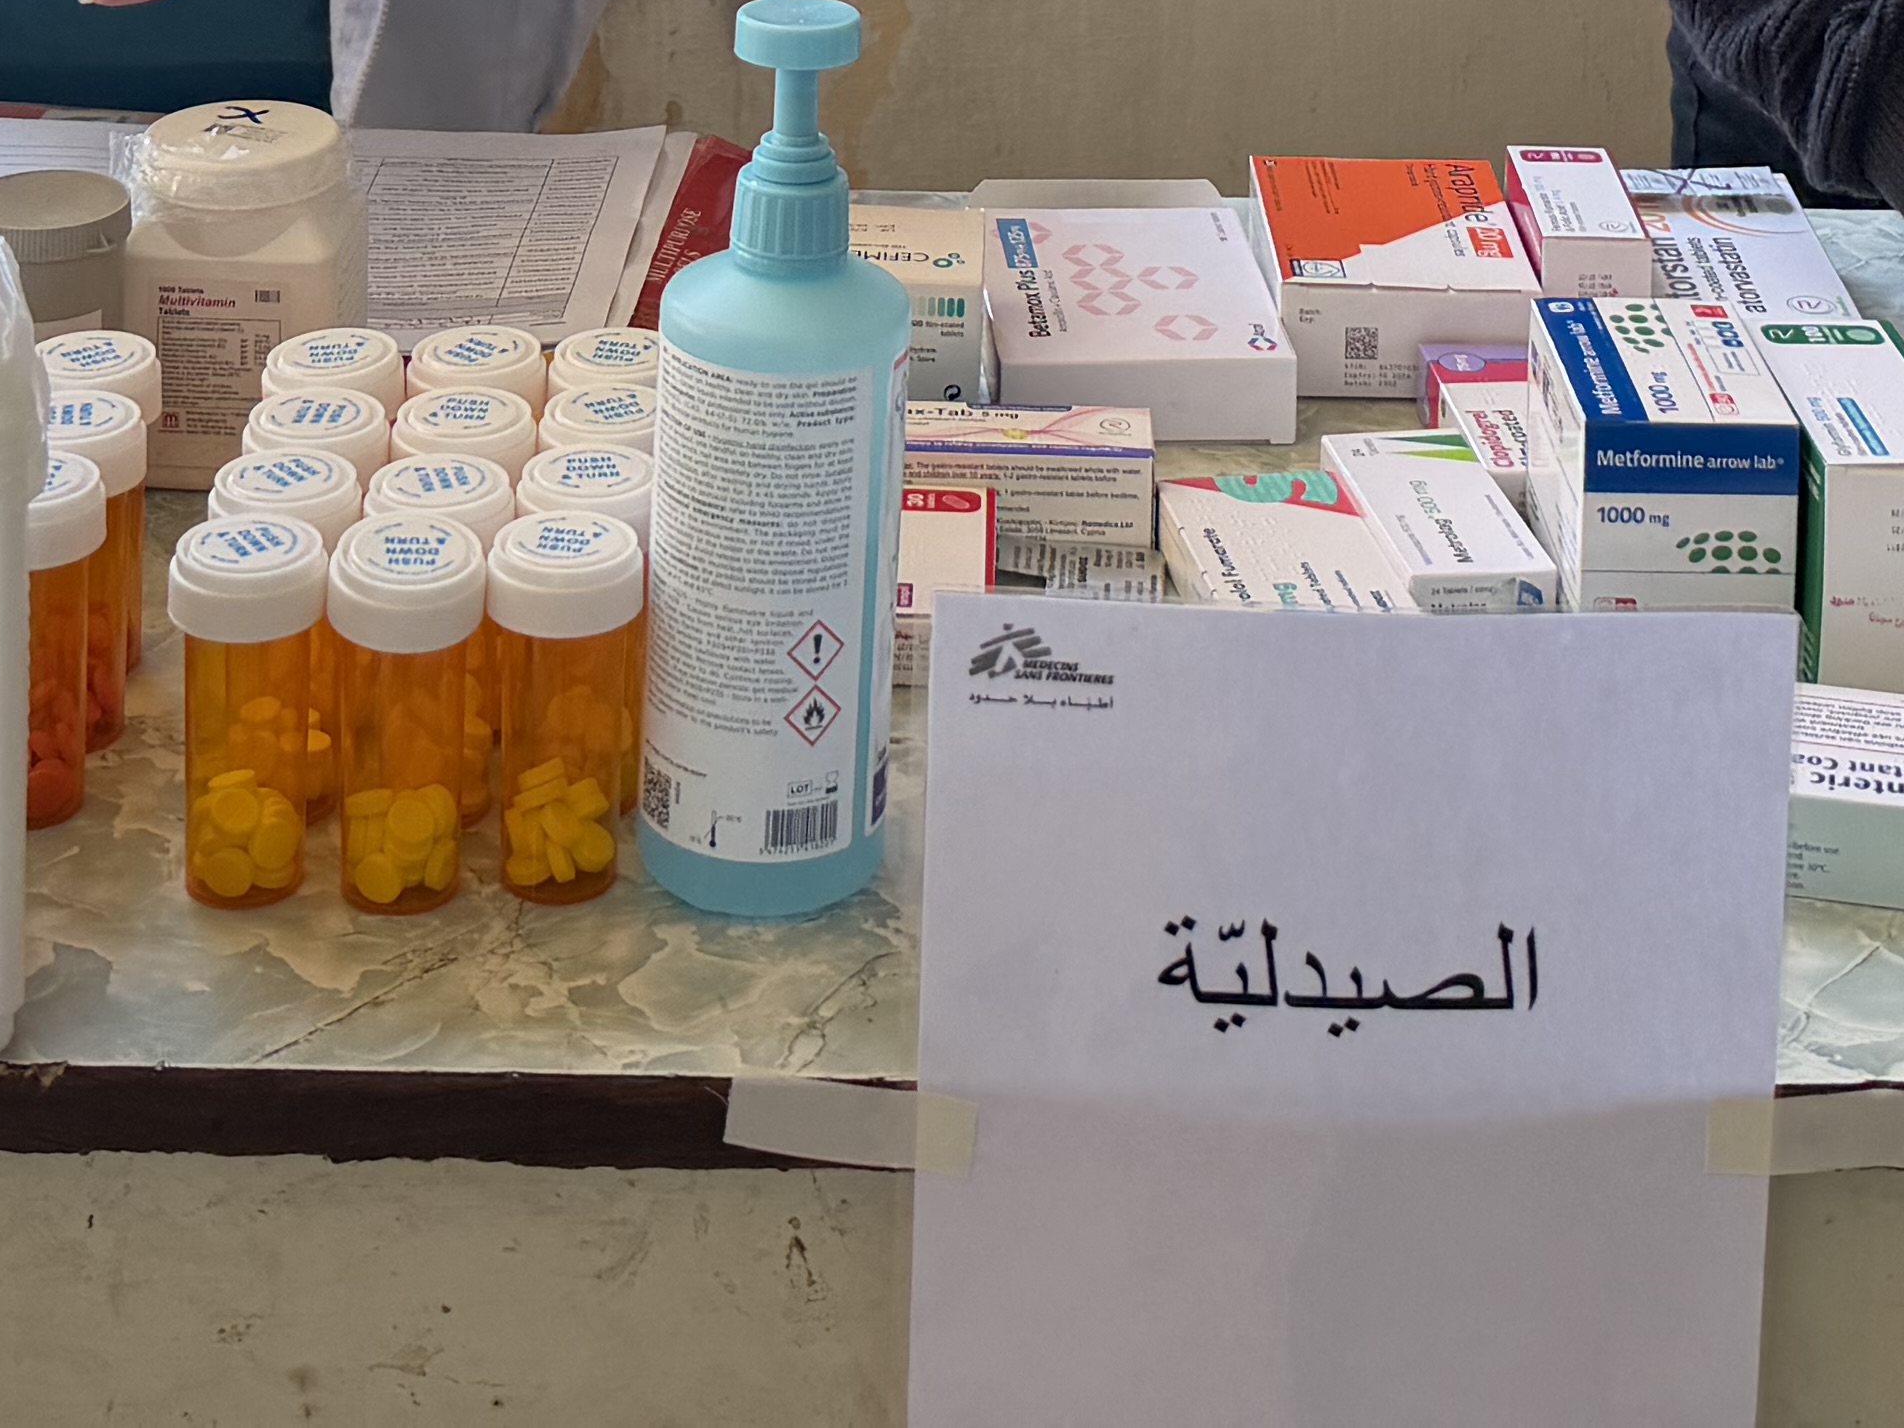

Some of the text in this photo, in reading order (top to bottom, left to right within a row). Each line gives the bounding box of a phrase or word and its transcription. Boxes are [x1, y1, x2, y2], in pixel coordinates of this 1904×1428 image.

[1644, 212, 1672, 233] 20
[646, 207, 702, 284] MULTIPURPOSE
[1476, 241, 1503, 259] mg
[1711, 236, 1768, 315] atorvastatin
[158, 294, 237, 309] Multivitamin
[1016, 270, 1052, 339] Betamox Plus
[158, 307, 191, 317] Tablets
[1582, 357, 1622, 417] Metformine
[1648, 371, 1680, 415] 1000 mg
[439, 404, 490, 414] DOWN
[446, 397, 491, 407] PUSH
[445, 412, 487, 422] TURN
[797, 418, 832, 428] Product
[1466, 409, 1514, 469] Clopidogrel
[566, 455, 613, 465] PUSH
[1596, 448, 1705, 470] Metformine
[1707, 455, 1751, 470] arrow
[566, 463, 618, 473] DOWN
[576, 470, 621, 480] TURN
[1409, 479, 1429, 495] mg
[1416, 494, 1443, 518] 500
[1081, 519, 1118, 529] Remedica
[1596, 506, 1671, 527] 1000 mg
[384, 535, 431, 546] TURN
[385, 546, 440, 557] DOWN
[1202, 527, 1241, 578] Fumarate
[388, 556, 437, 567] PUSH
[1022, 658, 1081, 673] MEDECINS
[1013, 668, 1115, 686] SANS FRONTIERES
[1792, 752, 1839, 771] Coa
[789, 782, 810, 795] LOT
[1157, 914, 1539, 1038] الصيدليّة
